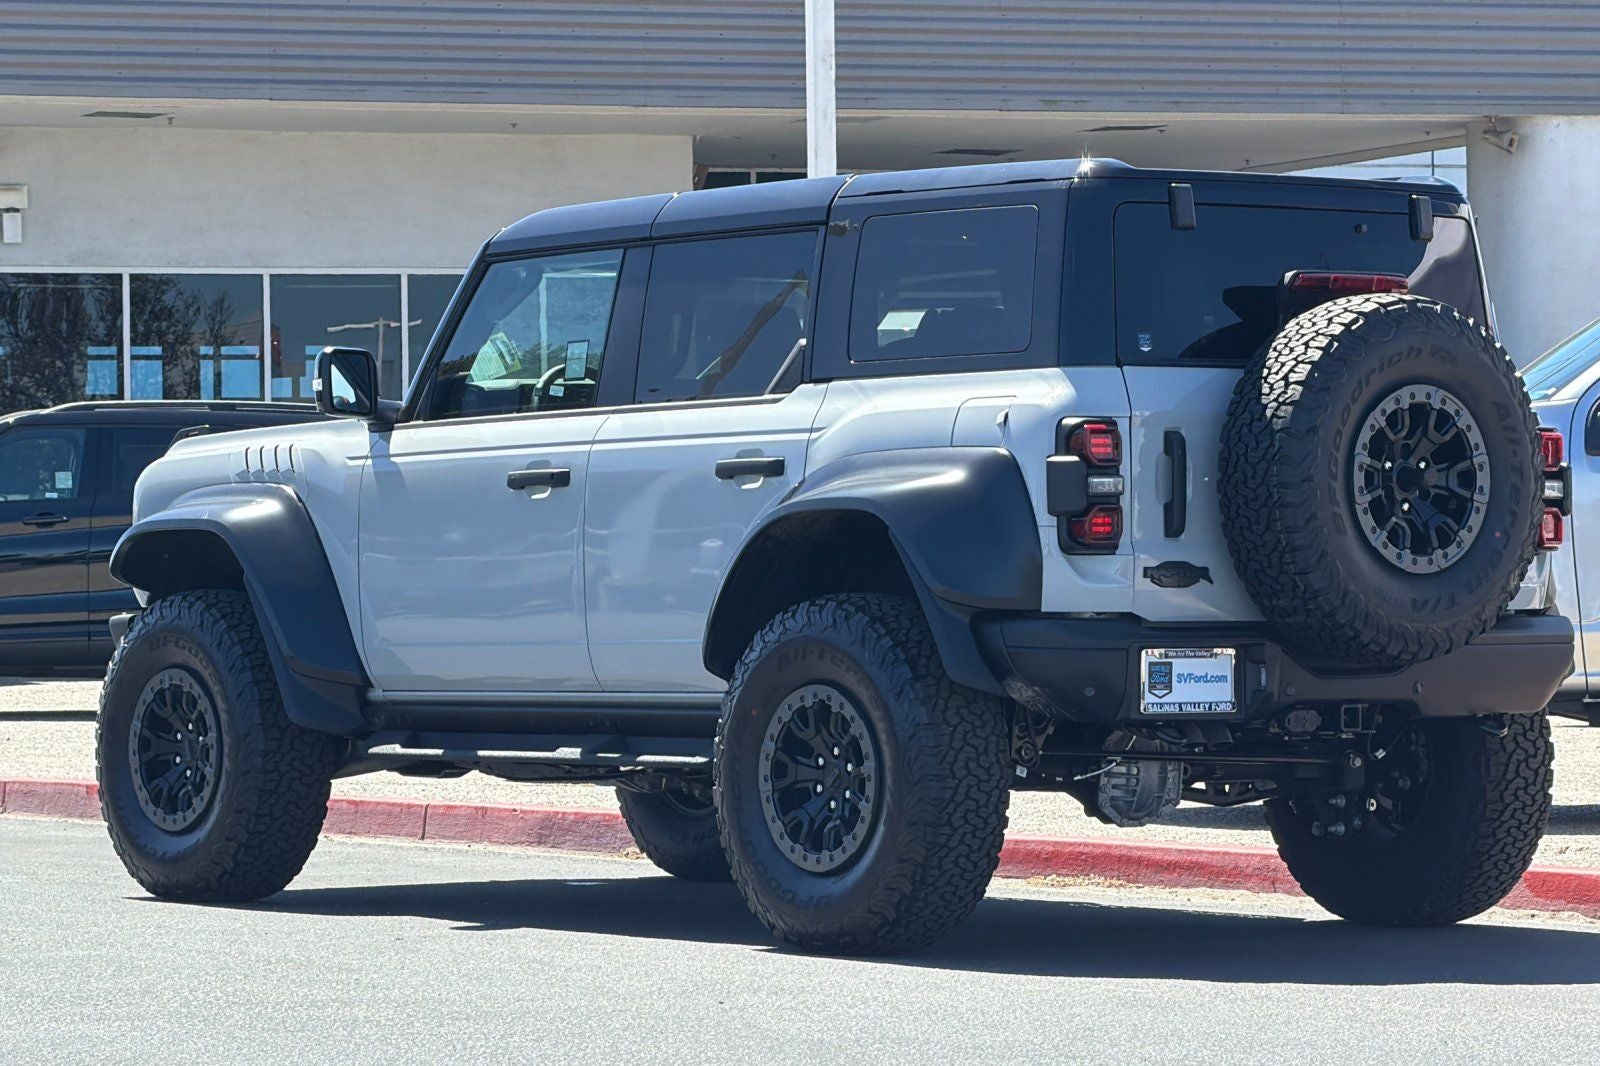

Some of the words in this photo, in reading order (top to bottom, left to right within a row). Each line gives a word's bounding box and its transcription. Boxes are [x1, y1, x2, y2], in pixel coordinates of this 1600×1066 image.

[1151, 673, 1169, 683] Ford
[1177, 673, 1227, 683] SVFord.com
[1148, 704, 1179, 712] SALINAS
[1182, 703, 1209, 711] VALLEY
[1212, 703, 1232, 711] FORD
